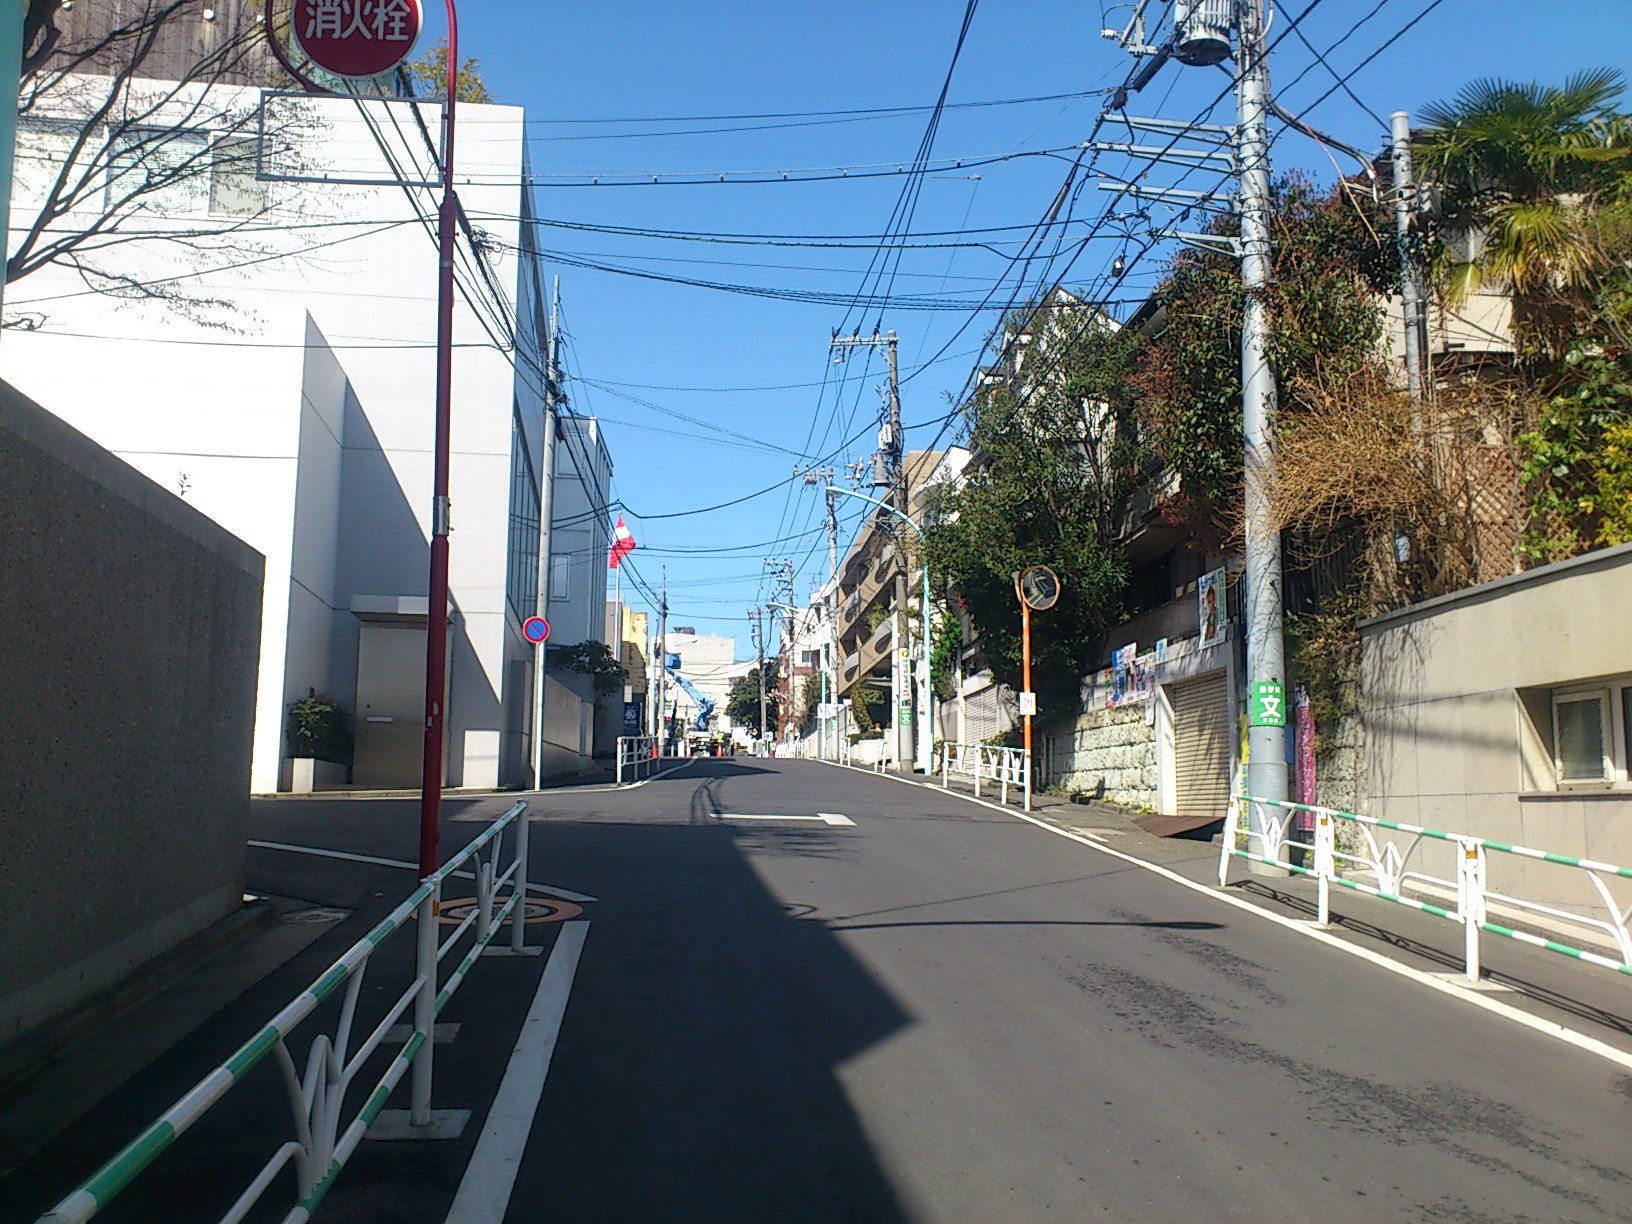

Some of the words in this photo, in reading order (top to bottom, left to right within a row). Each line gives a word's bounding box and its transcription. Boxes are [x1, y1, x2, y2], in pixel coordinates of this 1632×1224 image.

[304, 0, 411, 41] 消火栓
[1259, 695, 1282, 718] 文
